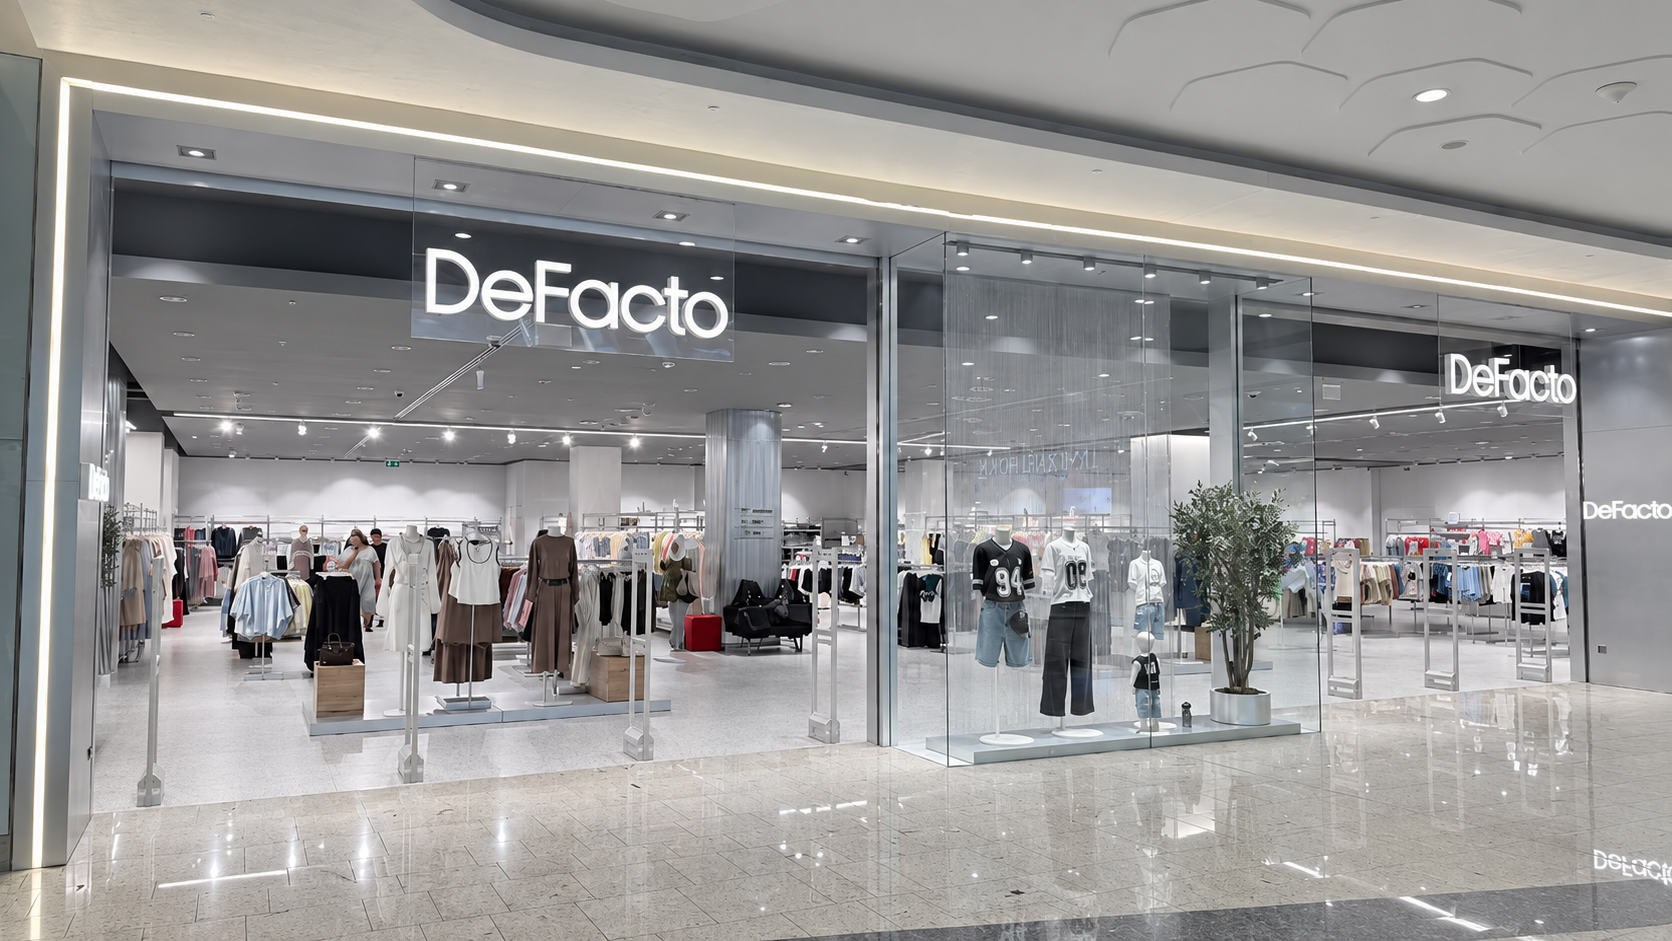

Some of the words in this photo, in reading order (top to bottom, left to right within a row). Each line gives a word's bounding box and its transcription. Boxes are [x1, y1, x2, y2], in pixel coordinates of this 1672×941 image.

[425, 247, 729, 339] DeFacto
[1444, 353, 1577, 405] DeFacto
[1582, 500, 1672, 520] DeFacto
[995, 566, 1023, 598] 94
